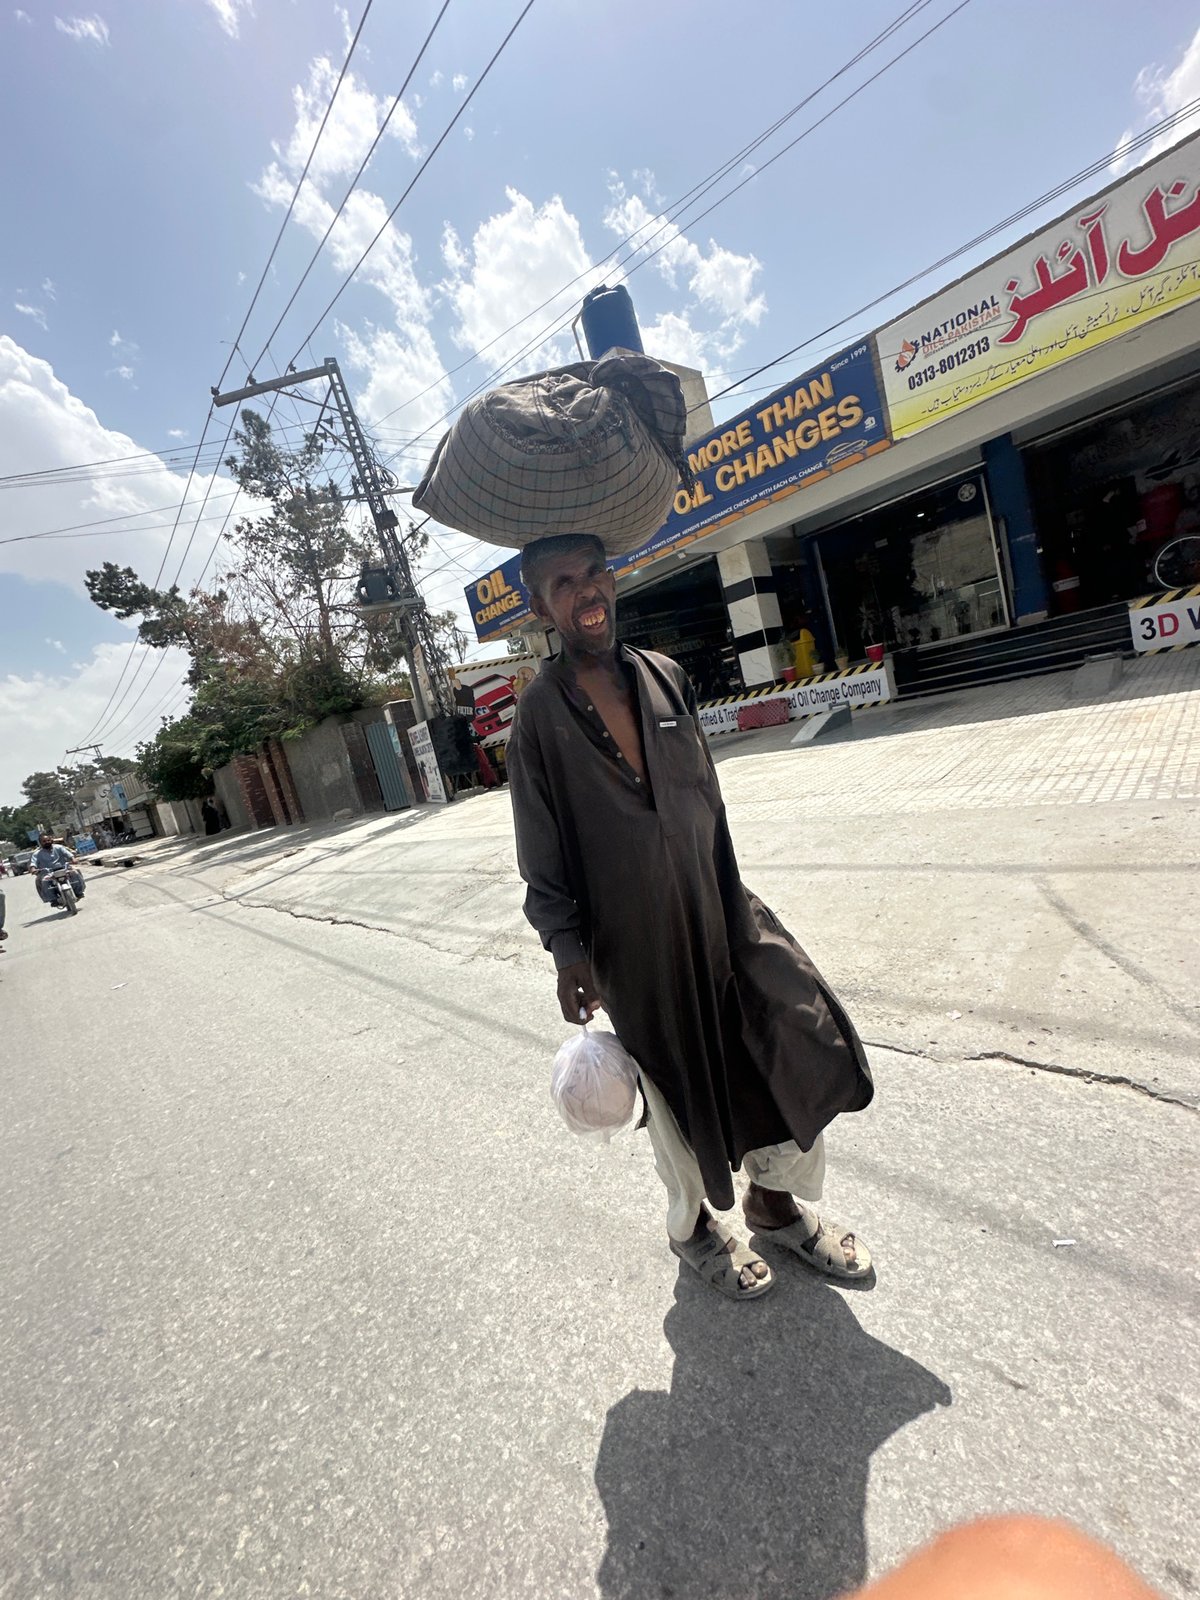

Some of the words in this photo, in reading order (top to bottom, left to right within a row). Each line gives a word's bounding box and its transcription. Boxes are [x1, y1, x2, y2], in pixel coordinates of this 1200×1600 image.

[921, 295, 999, 346] NATIONAL
[922, 336, 945, 355] OILS
[947, 306, 1000, 341] PAKISTAN
[830, 358, 849, 372] Since
[850, 345, 867, 360] 1999
[908, 336, 990, 390] 0313-8012313
[687, 419, 754, 475] MORE
[756, 372, 834, 434] THAN
[715, 394, 864, 492] CHANGES
[700, 506, 733, 526] MAINTENANCE
[733, 493, 758, 510] CHECK-UP
[758, 486, 772, 499] WITH
[773, 479, 788, 491] EACH
[788, 474, 798, 483] OIL
[798, 461, 823, 478] CHANGE
[475, 590, 523, 625] CHANGE
[477, 569, 513, 605] OIL
[1140, 612, 1179, 640] 3D
[718, 709, 725, 723] &
[797, 690, 809, 707] Oil
[809, 687, 840, 704] Change
[841, 679, 881, 699] Company
